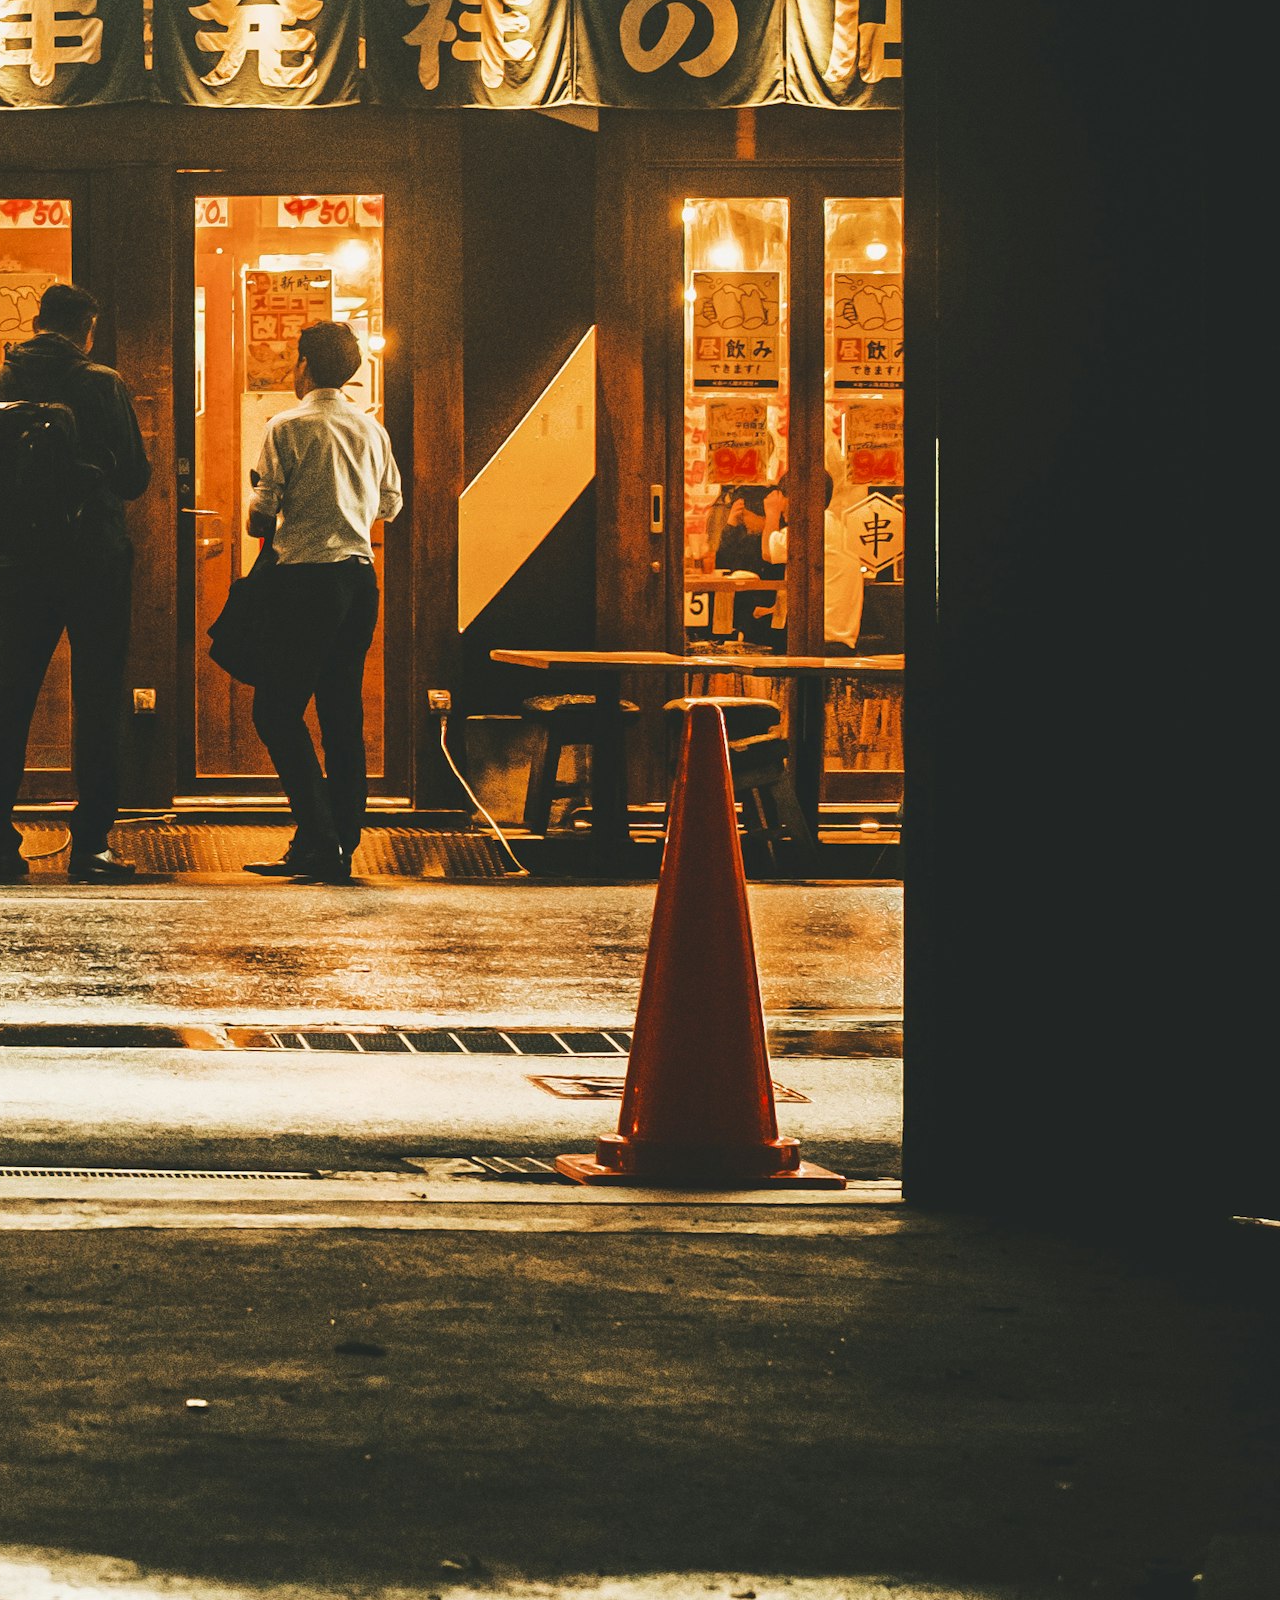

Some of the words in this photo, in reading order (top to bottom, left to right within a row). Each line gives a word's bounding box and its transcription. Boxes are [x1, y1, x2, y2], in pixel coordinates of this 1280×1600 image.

[252, 296, 324, 311] メニュー
[697, 337, 773, 360] 昼飲み
[859, 511, 894, 560] 串
[689, 592, 704, 615] 5
